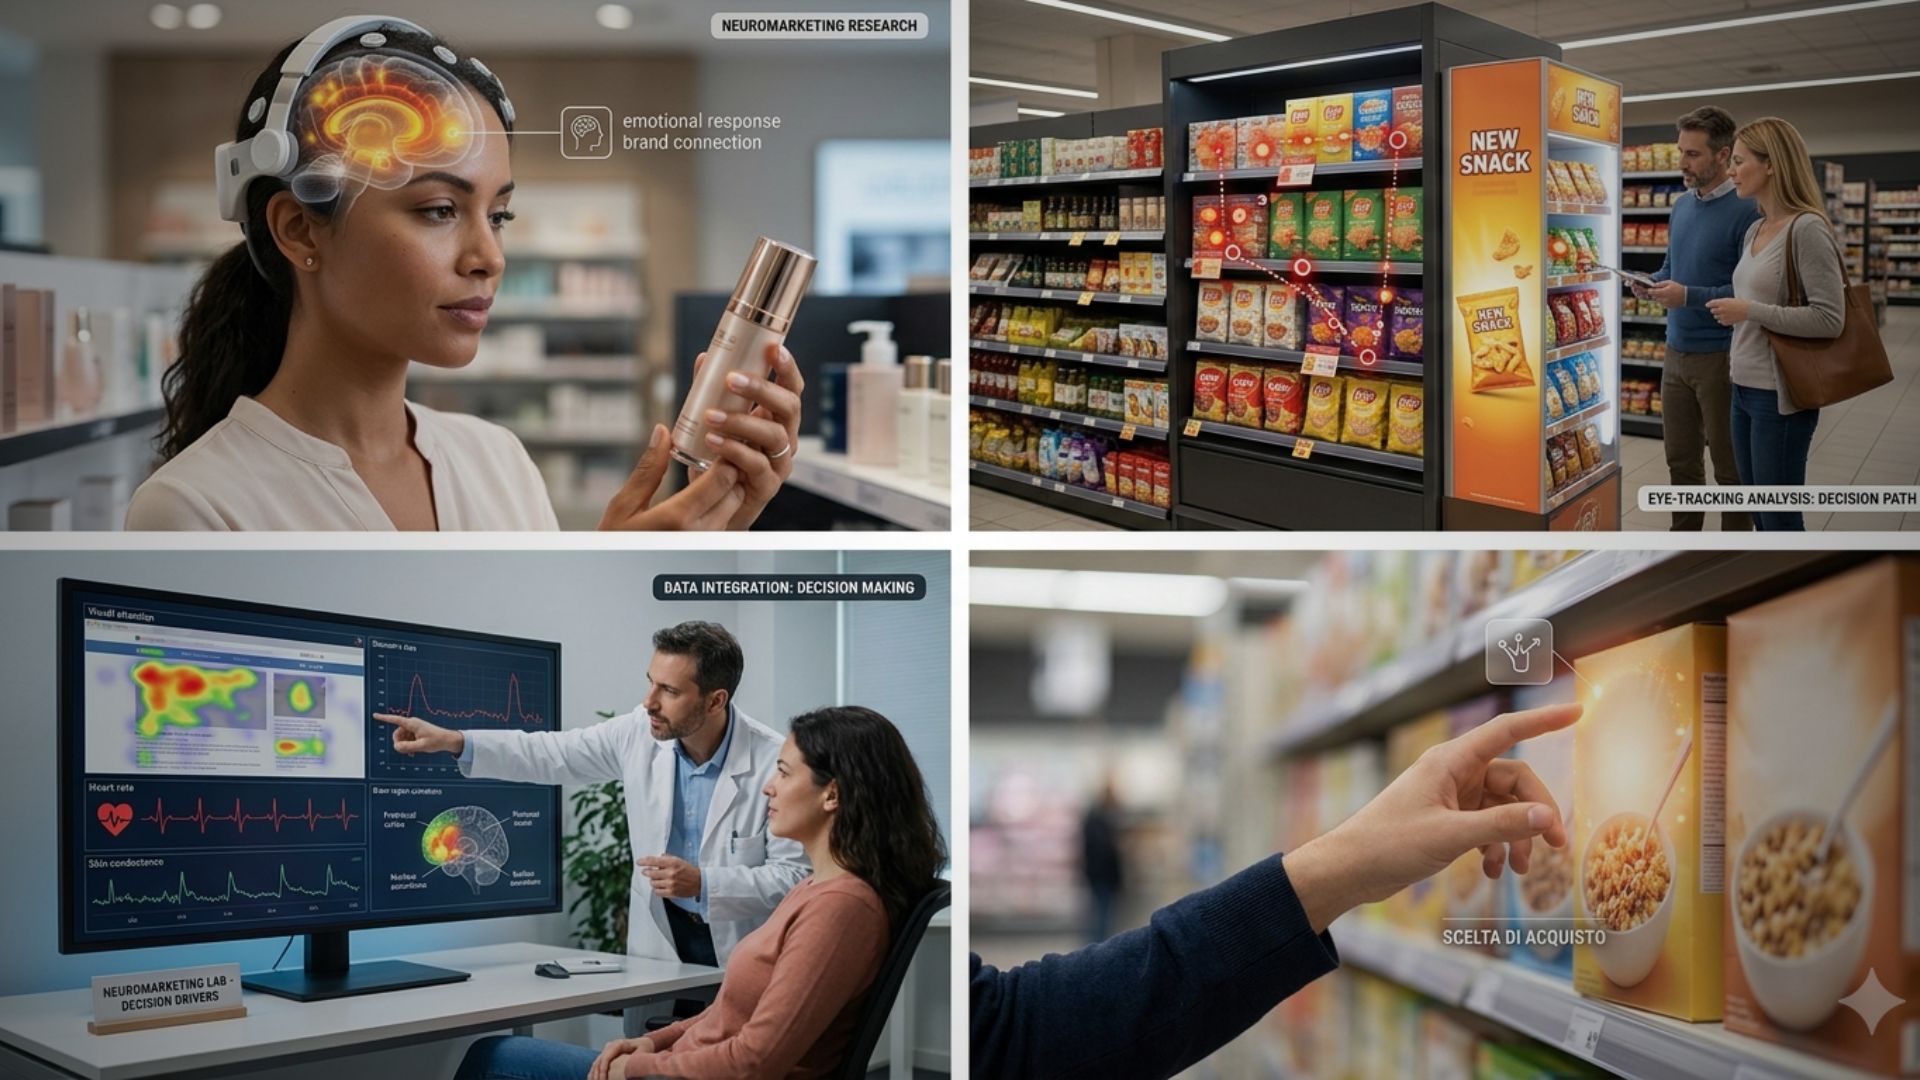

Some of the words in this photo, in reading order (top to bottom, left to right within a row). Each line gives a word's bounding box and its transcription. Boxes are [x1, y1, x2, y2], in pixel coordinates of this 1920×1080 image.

[1471, 129, 1519, 151] NEW
[1460, 151, 1531, 175] SNACK
[103, 978, 204, 998] NEUROMARKETING
[206, 975, 227, 988] LAB
[122, 995, 172, 1012] DECISION
[175, 991, 219, 1005] DRIVERS
